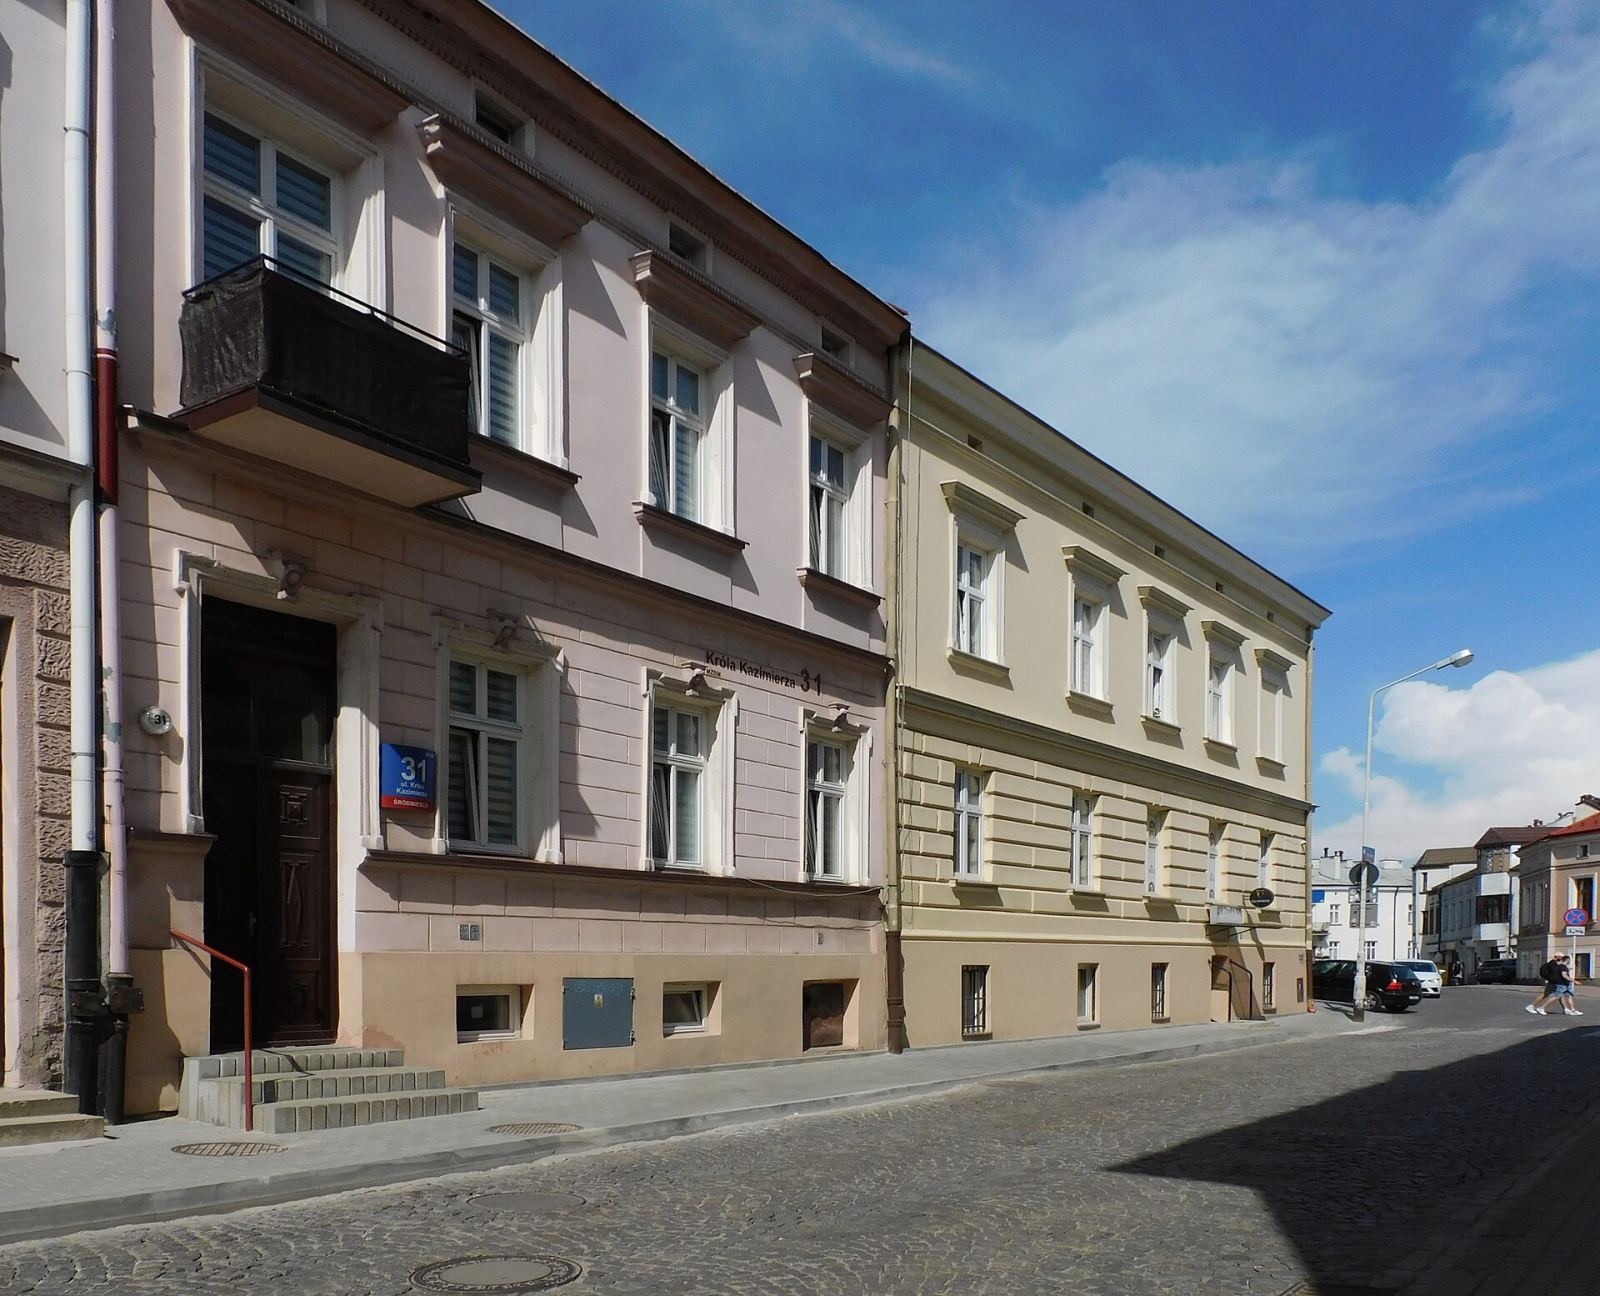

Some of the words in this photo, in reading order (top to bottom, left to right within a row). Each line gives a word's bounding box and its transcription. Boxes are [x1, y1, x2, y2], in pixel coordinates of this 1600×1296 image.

[706, 651, 736, 671] Króla
[740, 661, 796, 689] Kazimierza
[801, 669, 821, 696] 31
[154, 714, 166, 725] 31
[401, 757, 426, 783] 31
